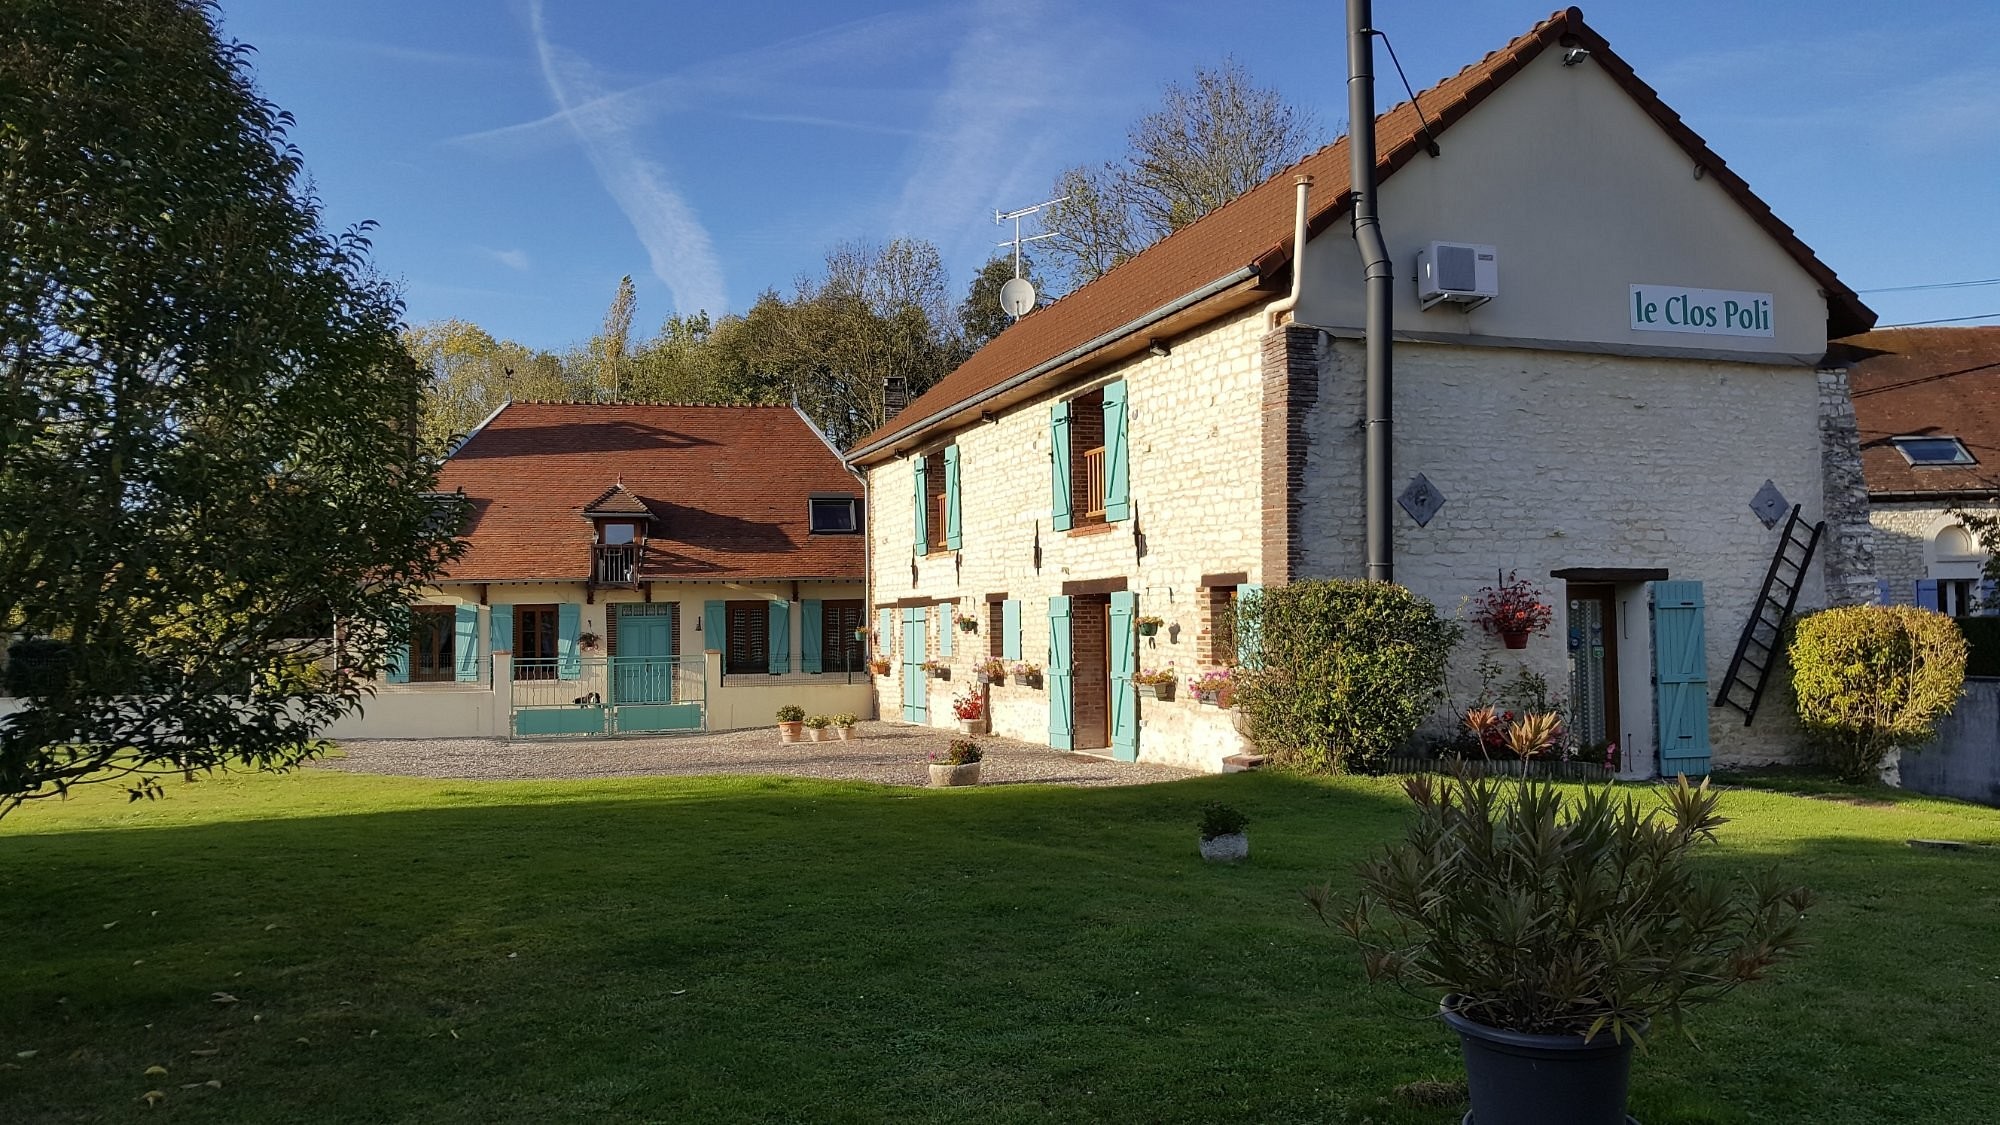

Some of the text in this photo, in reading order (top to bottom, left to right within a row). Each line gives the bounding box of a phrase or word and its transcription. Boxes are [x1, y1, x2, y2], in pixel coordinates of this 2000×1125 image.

[1634, 291, 1769, 330] le Clos Poli
